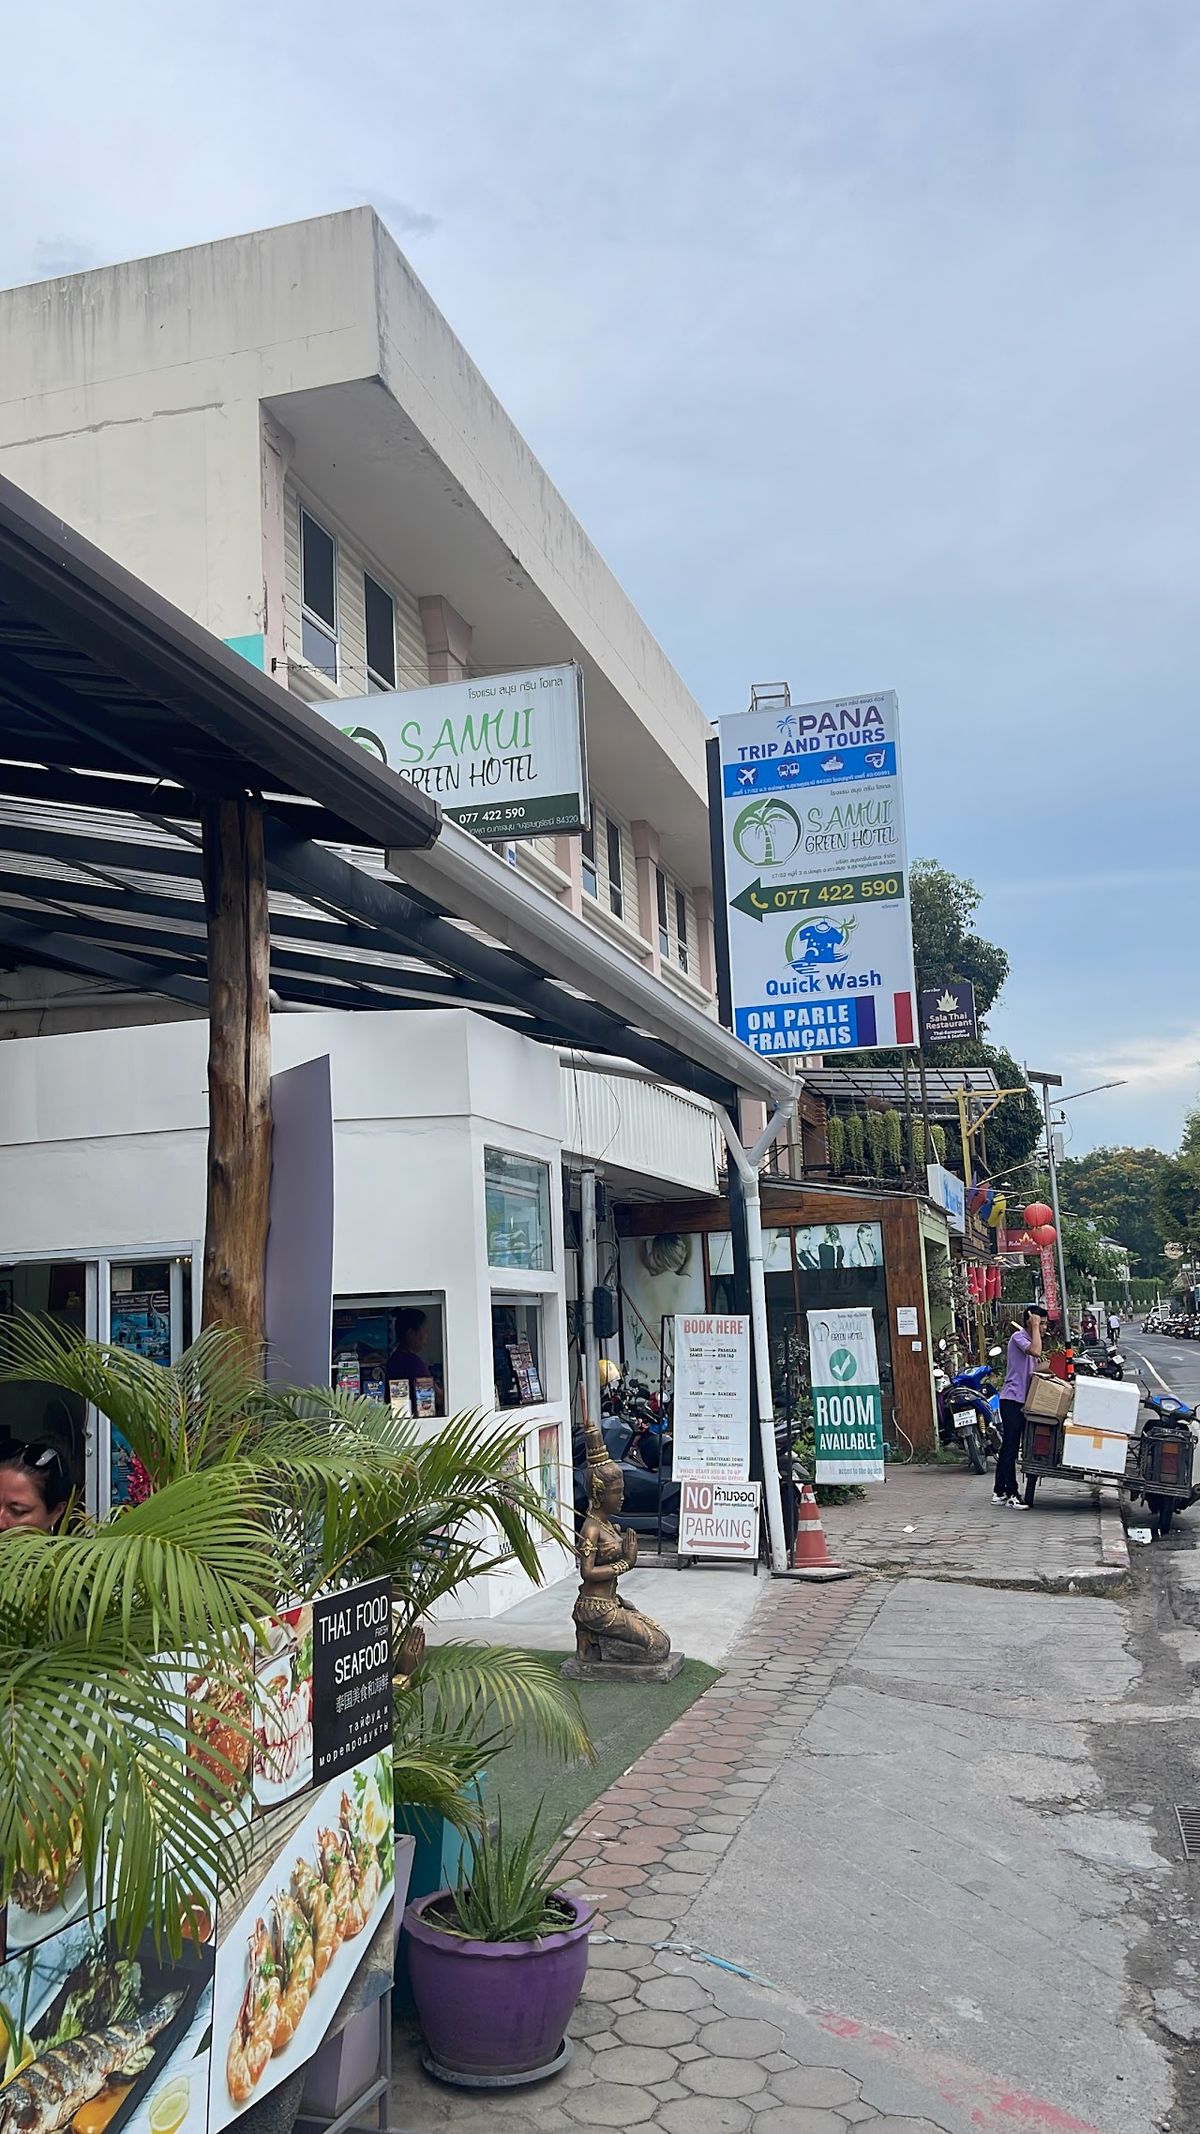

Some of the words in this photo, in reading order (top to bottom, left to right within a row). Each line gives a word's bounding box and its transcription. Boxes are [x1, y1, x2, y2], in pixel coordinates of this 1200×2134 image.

[468, 687, 496, 699] โรงแรม
[499, 685, 517, 696] สมุย
[799, 705, 884, 736] PANA
[400, 707, 535, 763] SAMUI
[738, 743, 778, 761] TRIP
[783, 737, 820, 757] AND
[825, 727, 885, 747] TOURS
[469, 754, 537, 787] HOTEL
[459, 813, 479, 824] 077
[482, 810, 502, 820] 422
[505, 807, 525, 819] 590
[556, 815, 579, 825] 84320
[807, 799, 895, 833] SAMUI
[805, 831, 849, 853] GREEN
[852, 826, 897, 848] HOTEL
[774, 888, 810, 908] 077
[818, 884, 854, 902] 422
[861, 879, 898, 898] 590
[766, 976, 821, 996] Quick
[826, 970, 882, 990] Wash
[748, 1011, 775, 1031] ON
[784, 1004, 849, 1028] PARLE
[926, 1019, 972, 1030] Restaurant
[930, 1014, 948, 1022] Sala
[948, 1012, 967, 1020] Thai
[748, 1025, 851, 1050] FRANÇAIS
[684, 1319, 713, 1334] BOOK
[716, 1319, 743, 1335] HERE
[831, 1320, 861, 1332] SAMUI
[817, 1395, 875, 1427] ROOM
[820, 1432, 877, 1450] AVAILABLE
[686, 1486, 712, 1510] NO
[714, 1486, 755, 1503] ห้ามจอด
[686, 1517, 751, 1538] PARKING
[319, 1608, 352, 1646] THAI
[356, 1595, 389, 1631] FOOD
[374, 1625, 389, 1639] FRESH
[334, 1639, 389, 1685] SEAFOOD
[336, 1672, 389, 1714] 泰国美食和海鲜
[349, 1709, 381, 1734] тайфуд
[319, 1721, 389, 1767] морепродукты
